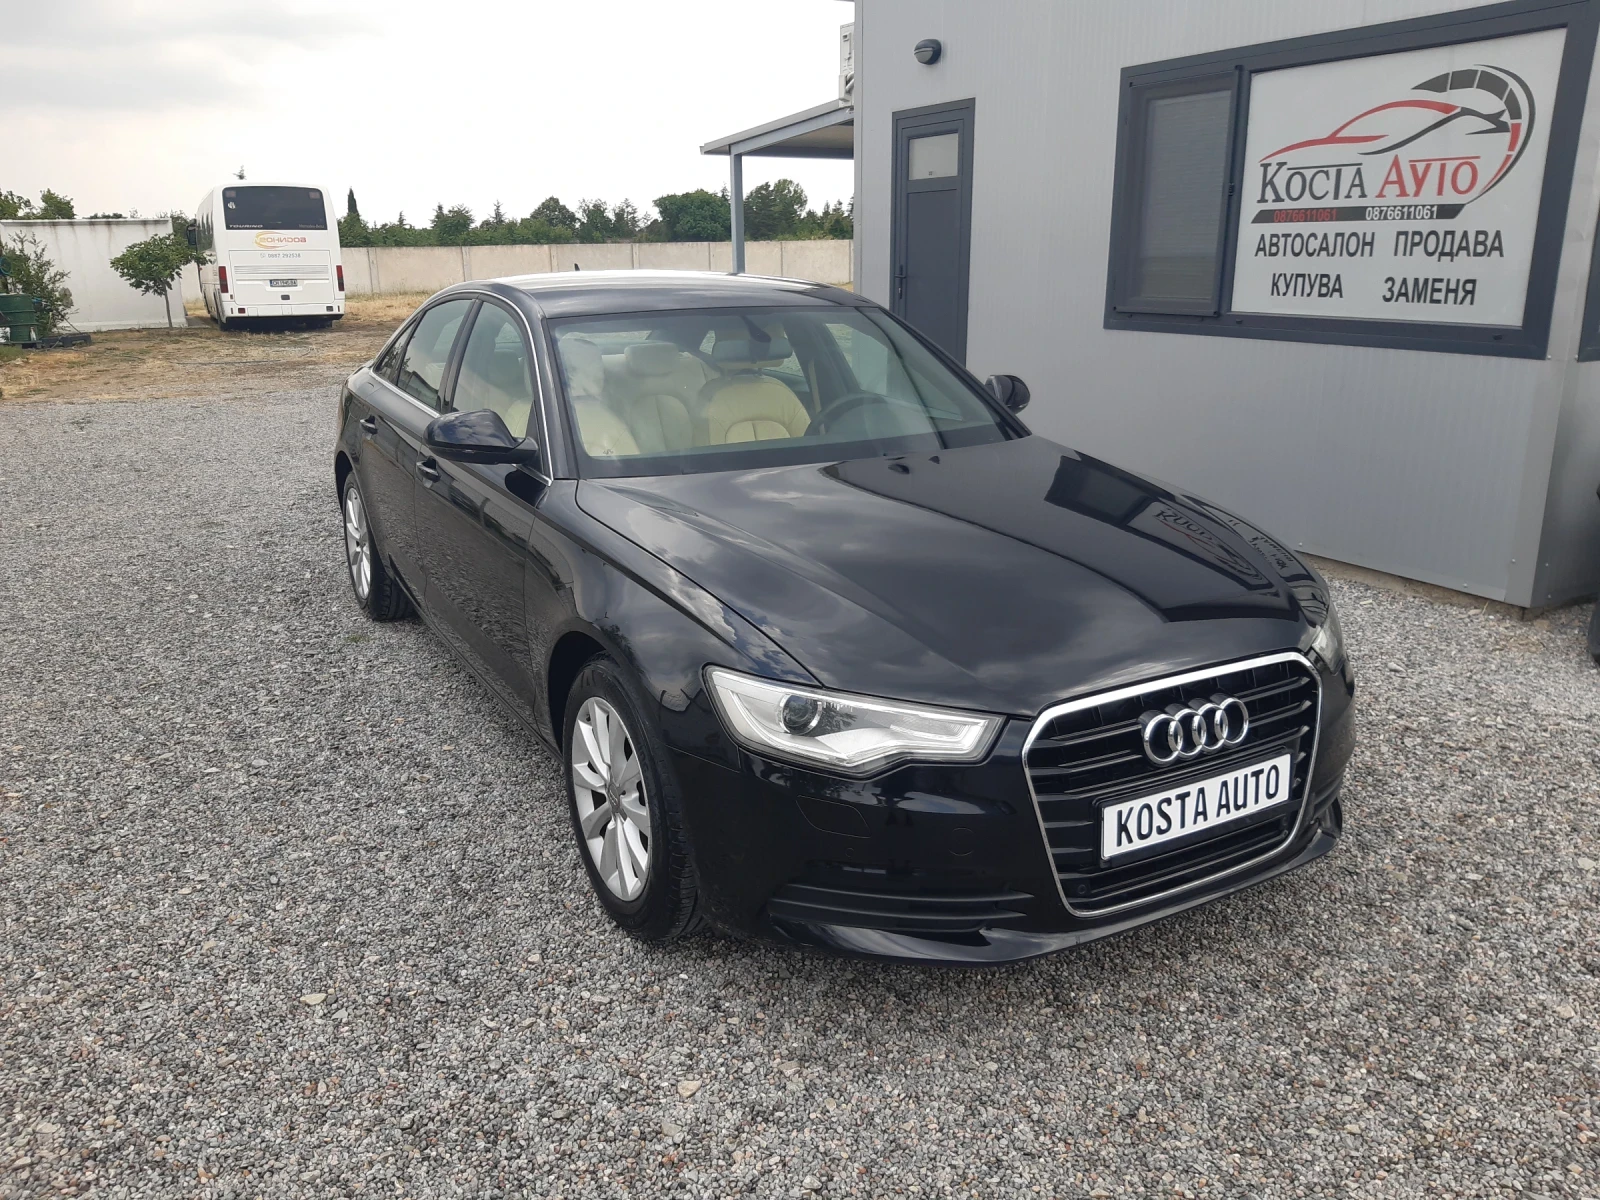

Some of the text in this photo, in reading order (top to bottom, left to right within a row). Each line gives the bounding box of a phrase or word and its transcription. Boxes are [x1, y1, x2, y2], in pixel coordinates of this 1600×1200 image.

[1273, 205, 1438, 223] 0876611061 0876611061
[1254, 230, 1504, 262] АВТОСАЛОН ПРОДАВА
[1270, 273, 1344, 298] КУПУВА
[1382, 277, 1477, 305] ЗАМЕНЯ
[1116, 764, 1280, 847] KOSTA AUTO
